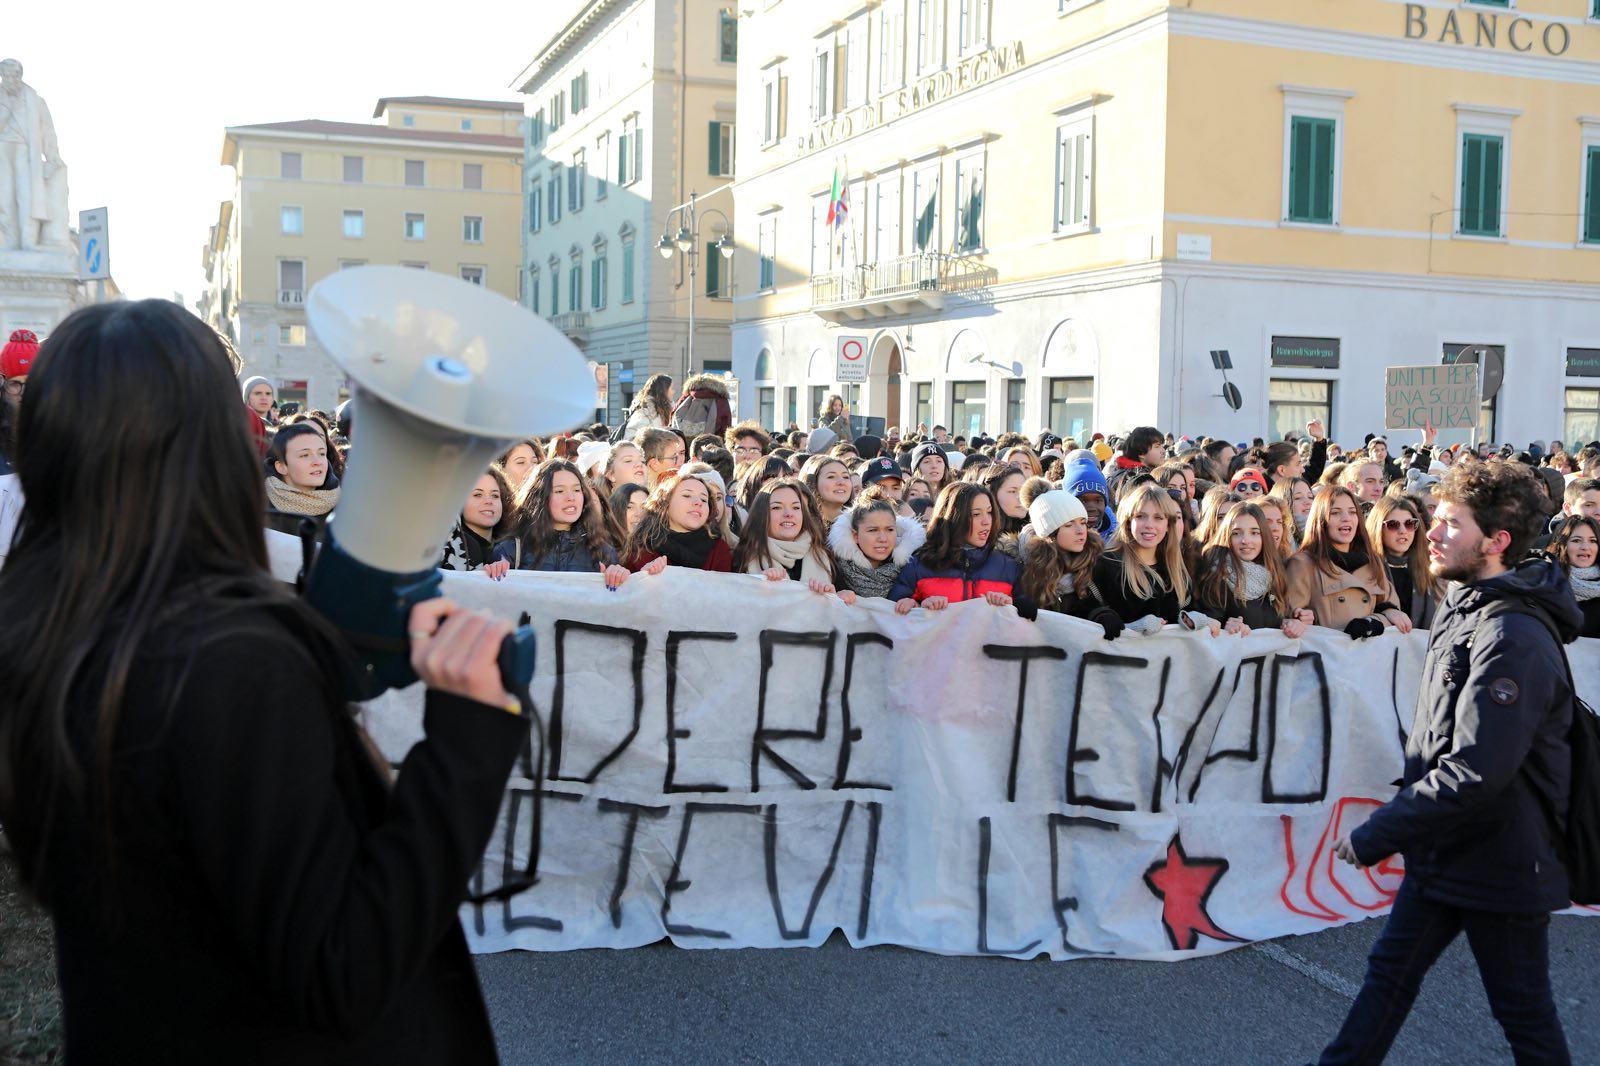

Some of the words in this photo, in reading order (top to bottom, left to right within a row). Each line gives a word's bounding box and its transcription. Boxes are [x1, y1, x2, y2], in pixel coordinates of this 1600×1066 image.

[1404, 3, 1570, 56] BANCO
[898, 40, 1026, 117] SARDEGNA
[1388, 367, 1436, 387] UNITI
[1447, 365, 1474, 385] PER
[1388, 389, 1425, 406] UNA
[1391, 405, 1475, 429] SICURA
[1076, 481, 1106, 494] GUES
